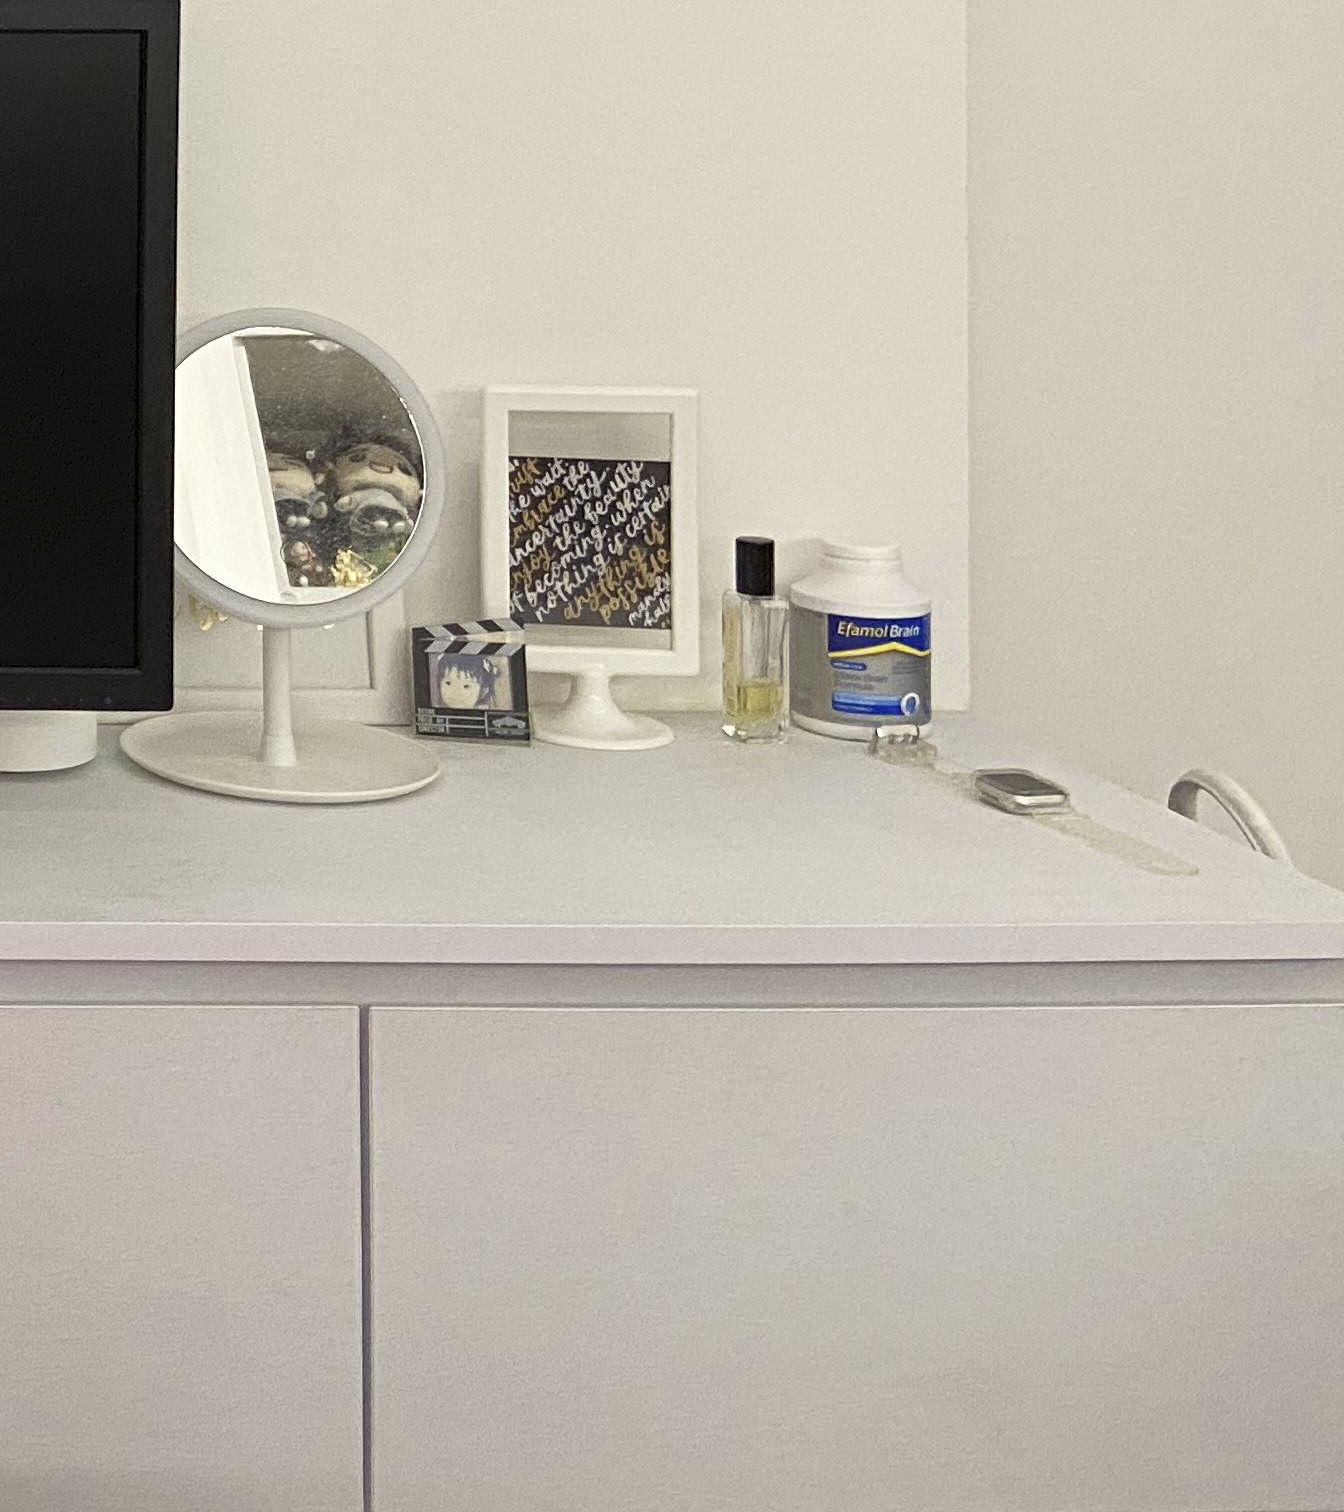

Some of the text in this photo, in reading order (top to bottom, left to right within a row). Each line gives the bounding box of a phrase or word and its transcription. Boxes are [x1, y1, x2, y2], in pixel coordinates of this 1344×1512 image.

[511, 484, 565, 543] mbrace
[553, 521, 586, 551] the
[584, 461, 644, 525] beauty
[611, 476, 656, 527] when
[535, 553, 611, 623] nothing
[564, 521, 666, 620] anything is
[600, 549, 670, 625] possible
[837, 621, 920, 638] Efamol Brain
